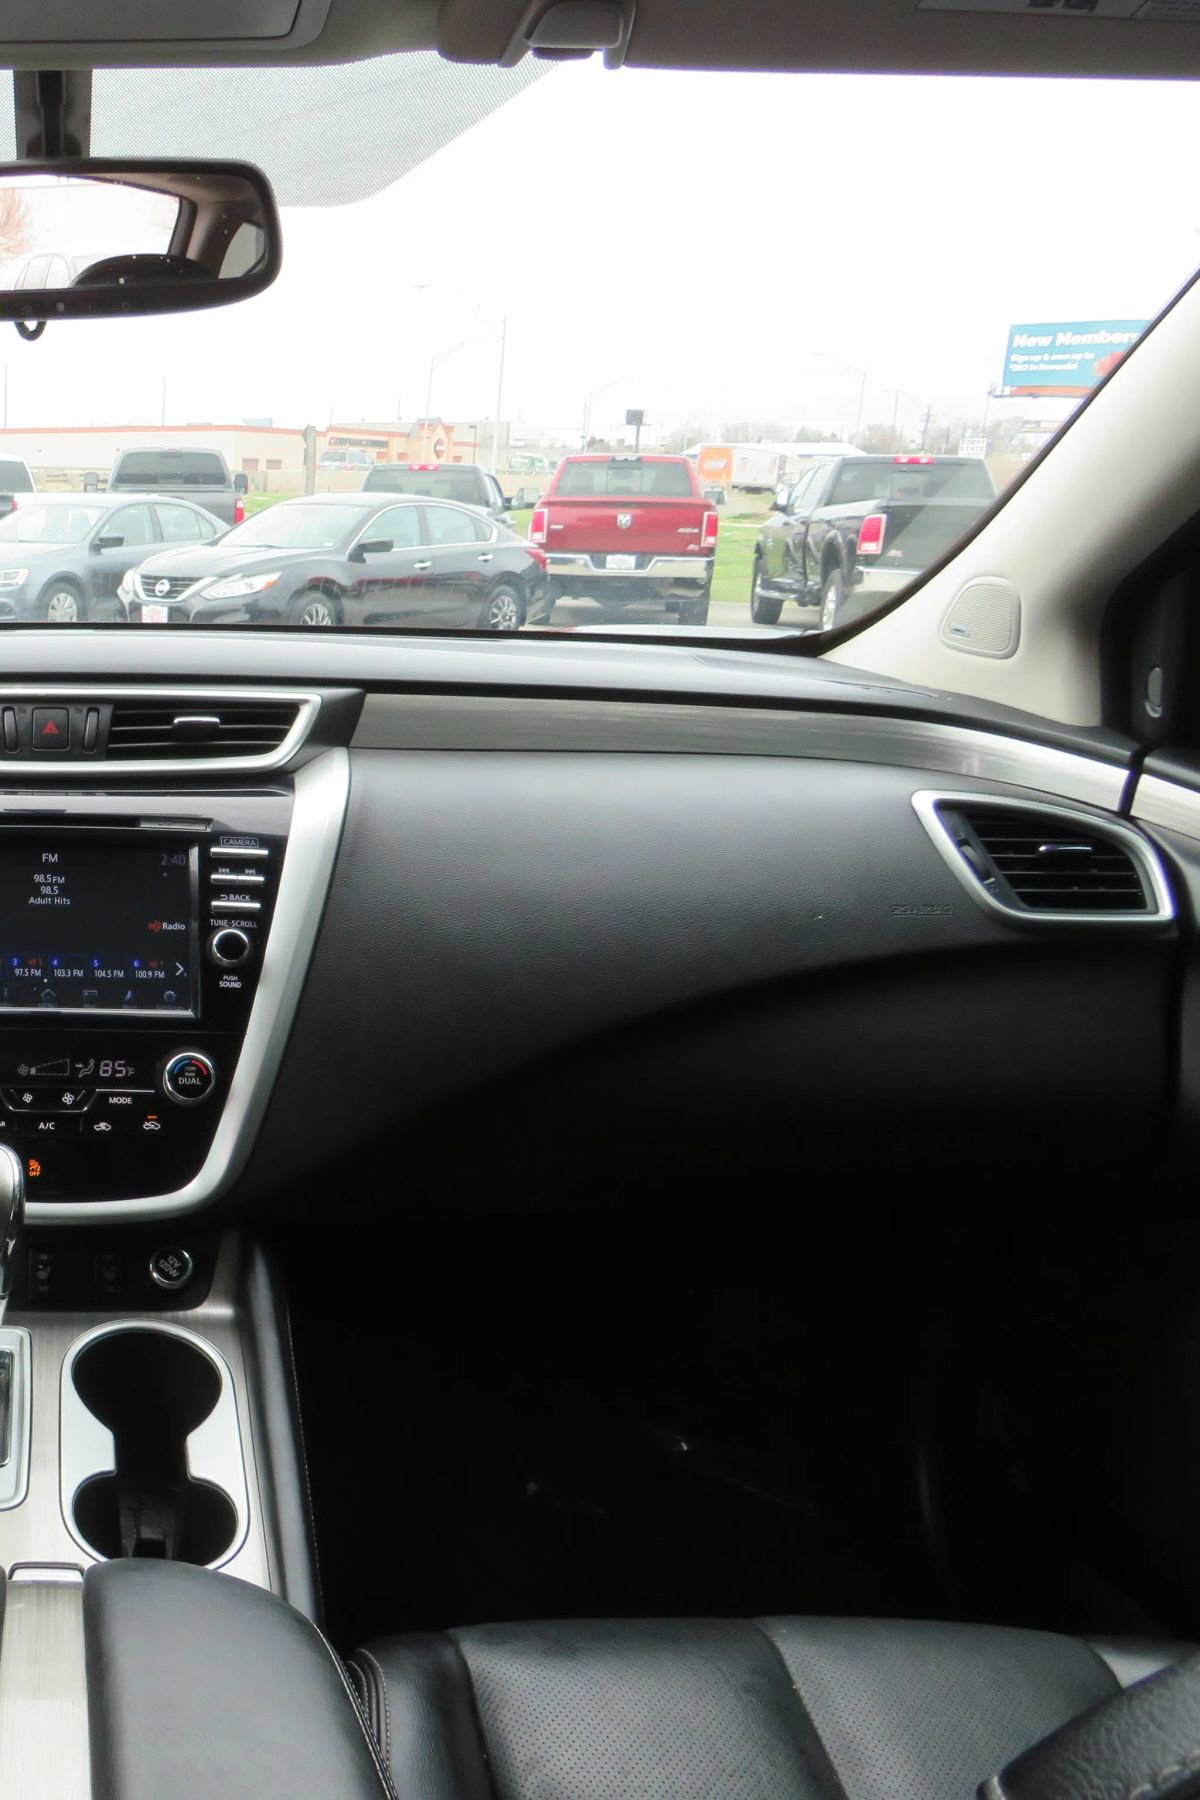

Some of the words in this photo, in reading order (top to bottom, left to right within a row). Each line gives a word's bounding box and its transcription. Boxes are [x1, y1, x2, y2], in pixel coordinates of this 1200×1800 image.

[1013, 333, 1054, 348] New
[222, 838, 257, 846] CAMERA
[42, 853, 58, 863] FM
[160, 854, 186, 866] 2:40
[40, 886, 59, 895] 98.5
[28, 896, 52, 905] Adult
[54, 896, 71, 905] Hits
[162, 922, 186, 930] Radio
[15, 969, 29, 977] 97.5
[53, 969, 71, 977] 103.3
[73, 969, 84, 977] FM
[94, 969, 112, 978] 104.5
[113, 970, 124, 978] FM
[135, 970, 153, 979] 100.9
[219, 981, 242, 989] SOUND
[178, 1077, 202, 1085] DUAL
[109, 1097, 133, 1105] MODE
[38, 1122, 56, 1130] A/C
[167, 1255, 182, 1268] 12V
[158, 1259, 180, 1278] 120W
